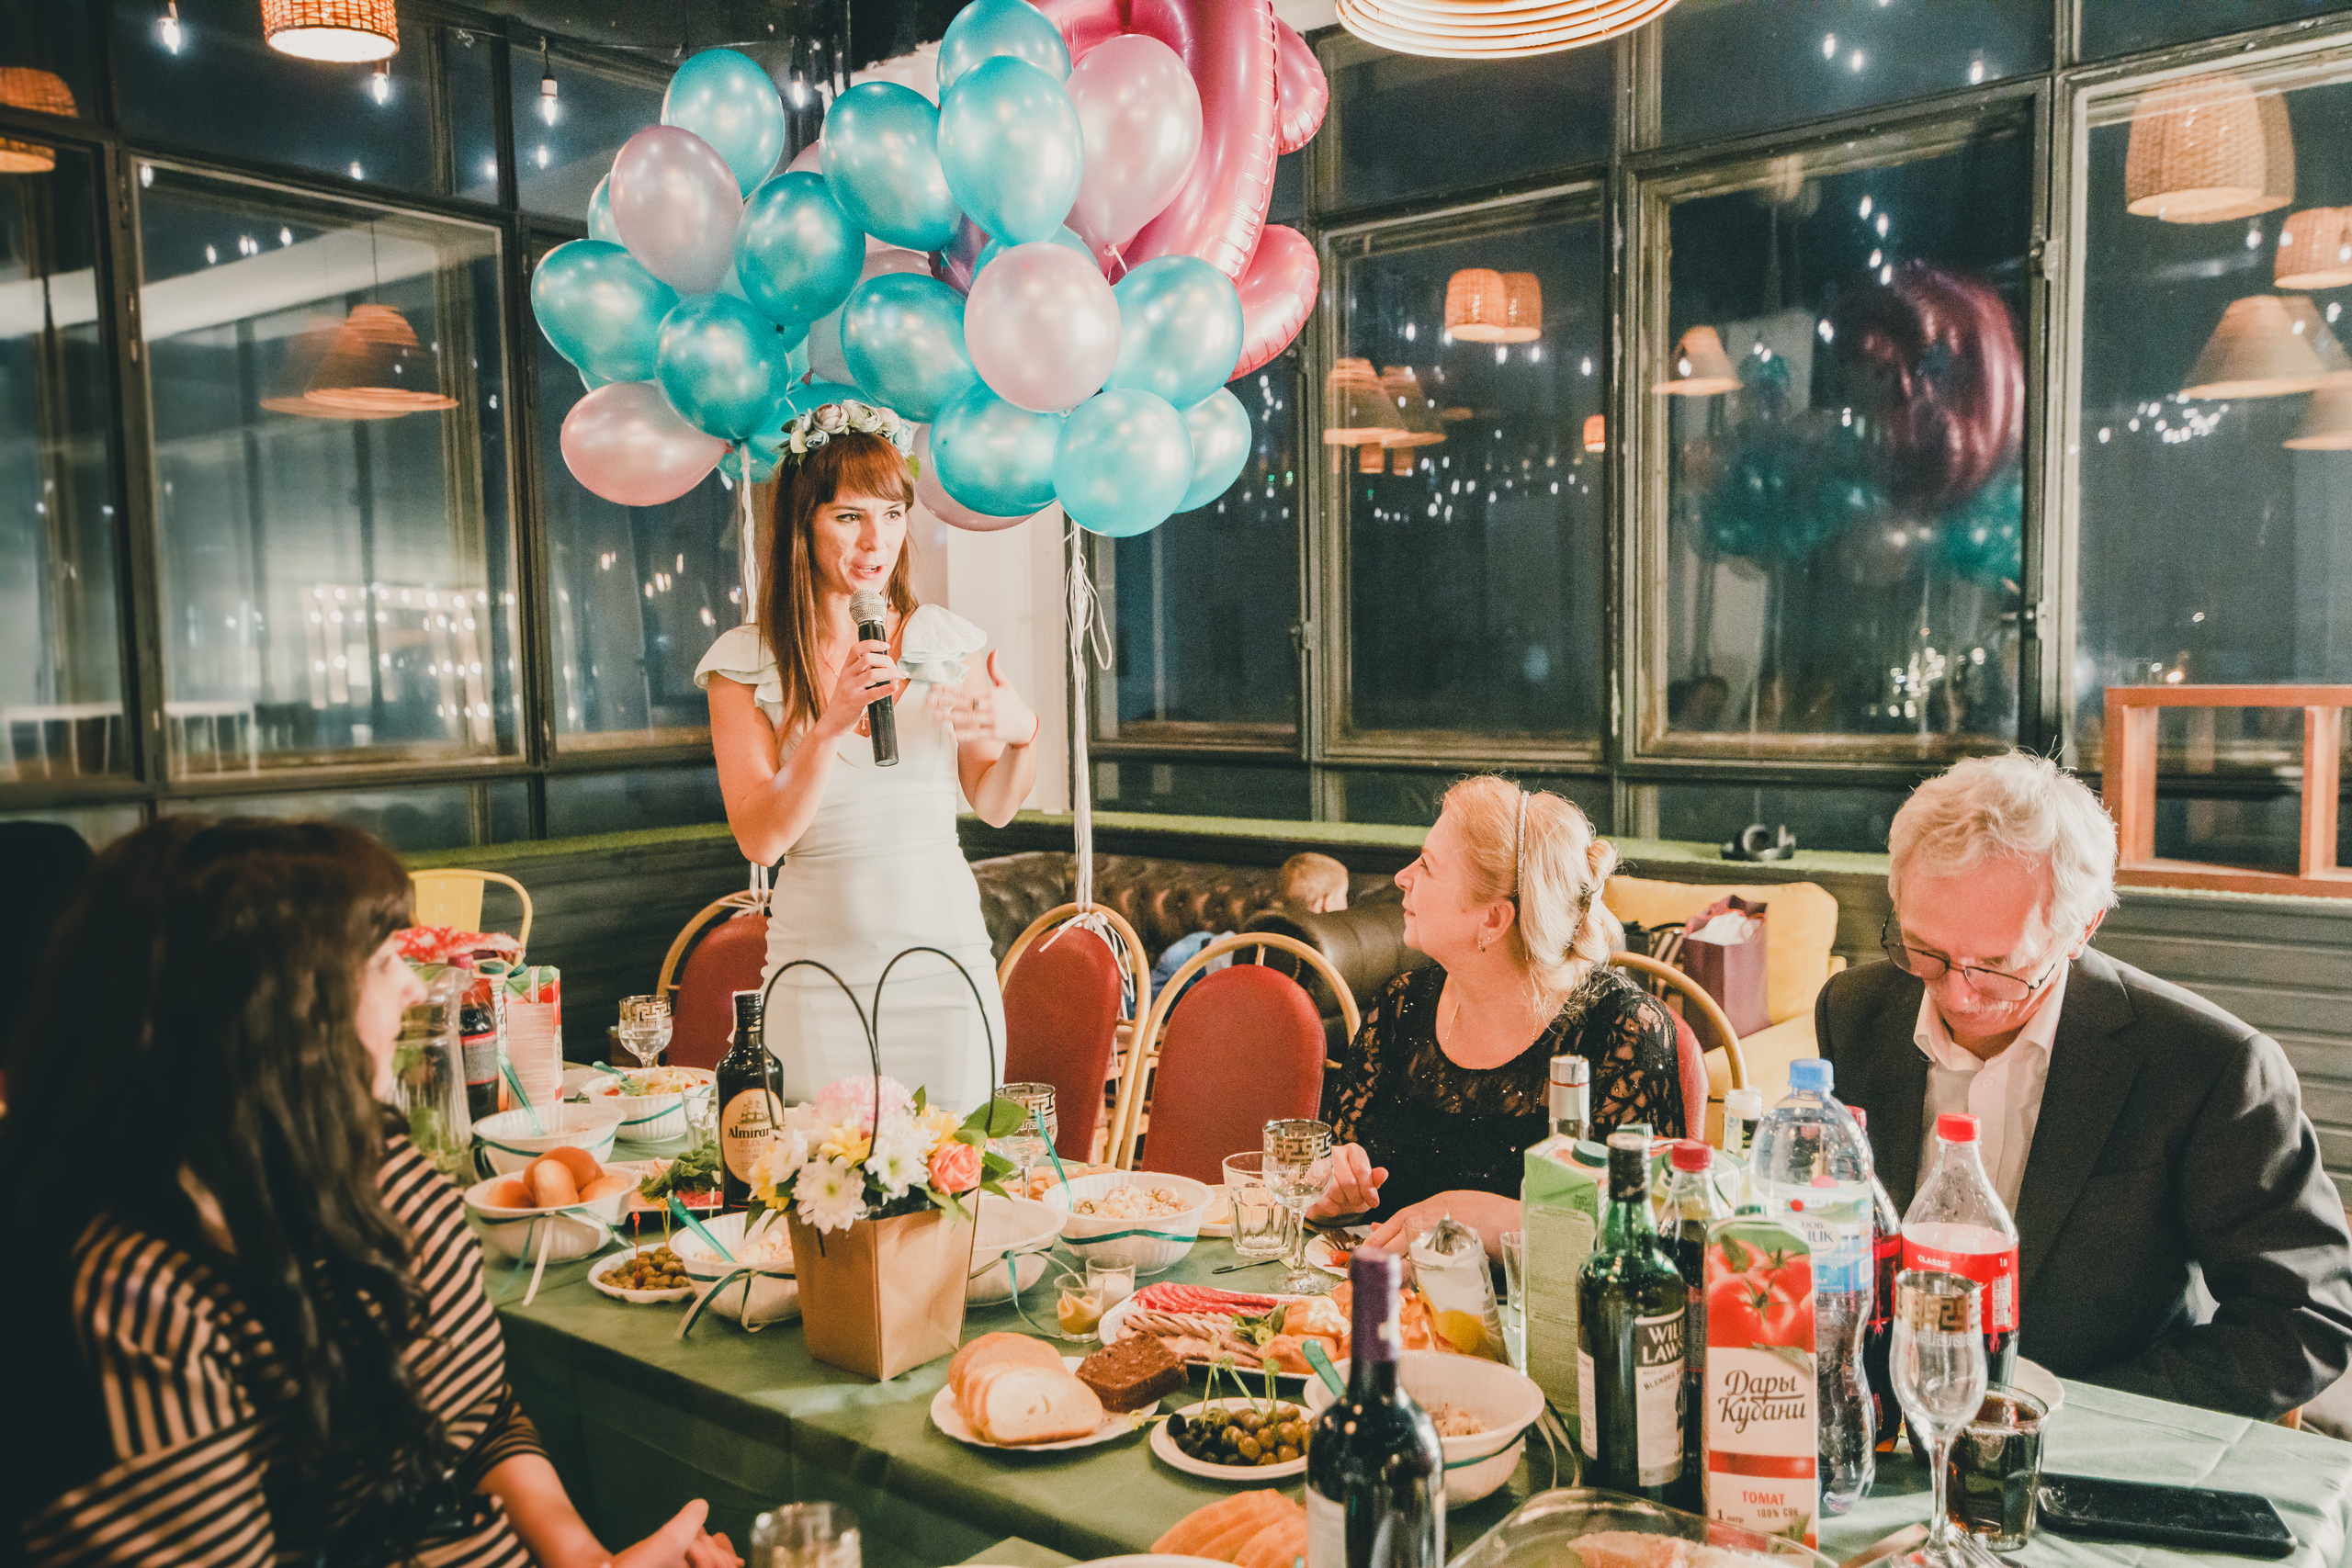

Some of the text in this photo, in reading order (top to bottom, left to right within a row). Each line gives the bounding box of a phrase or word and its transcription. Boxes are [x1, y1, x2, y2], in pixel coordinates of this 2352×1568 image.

[1917, 1254, 1951, 1269] CLASSIC
[1724, 1369, 1797, 1405] Дары
[1717, 1393, 1806, 1435] Кубани
[1741, 1491, 1785, 1506] ТОМАТ
[1716, 1508, 1724, 1520] 1
[1757, 1507, 1780, 1518] 100%
